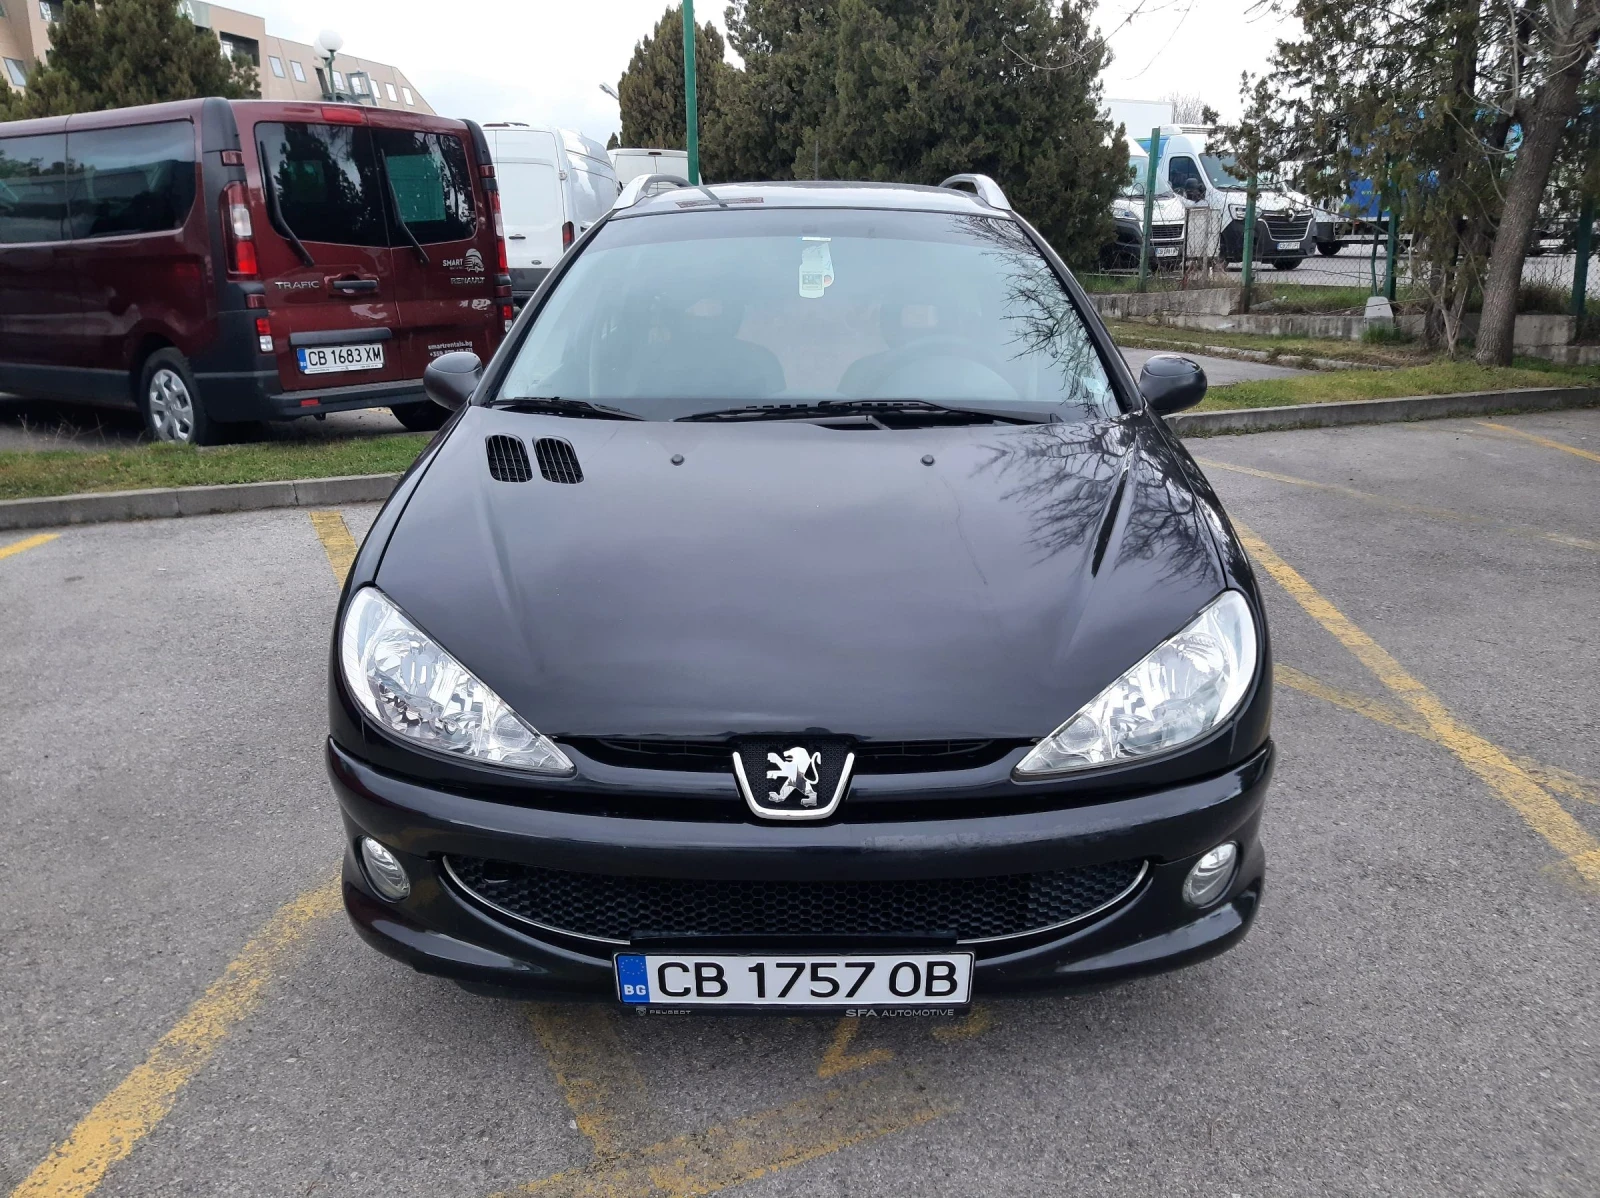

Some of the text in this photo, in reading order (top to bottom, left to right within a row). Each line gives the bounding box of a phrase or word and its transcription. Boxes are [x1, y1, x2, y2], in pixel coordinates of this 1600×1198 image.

[442, 258, 464, 267] SMART
[274, 280, 320, 289] TRAFIC
[450, 276, 486, 285] RENAULT
[308, 346, 382, 366] CB 1683 XM
[656, 960, 958, 999] CB 1757 OB
[623, 983, 647, 996] BG
[845, 1009, 955, 1017] SFA AUTOMOTIVE
